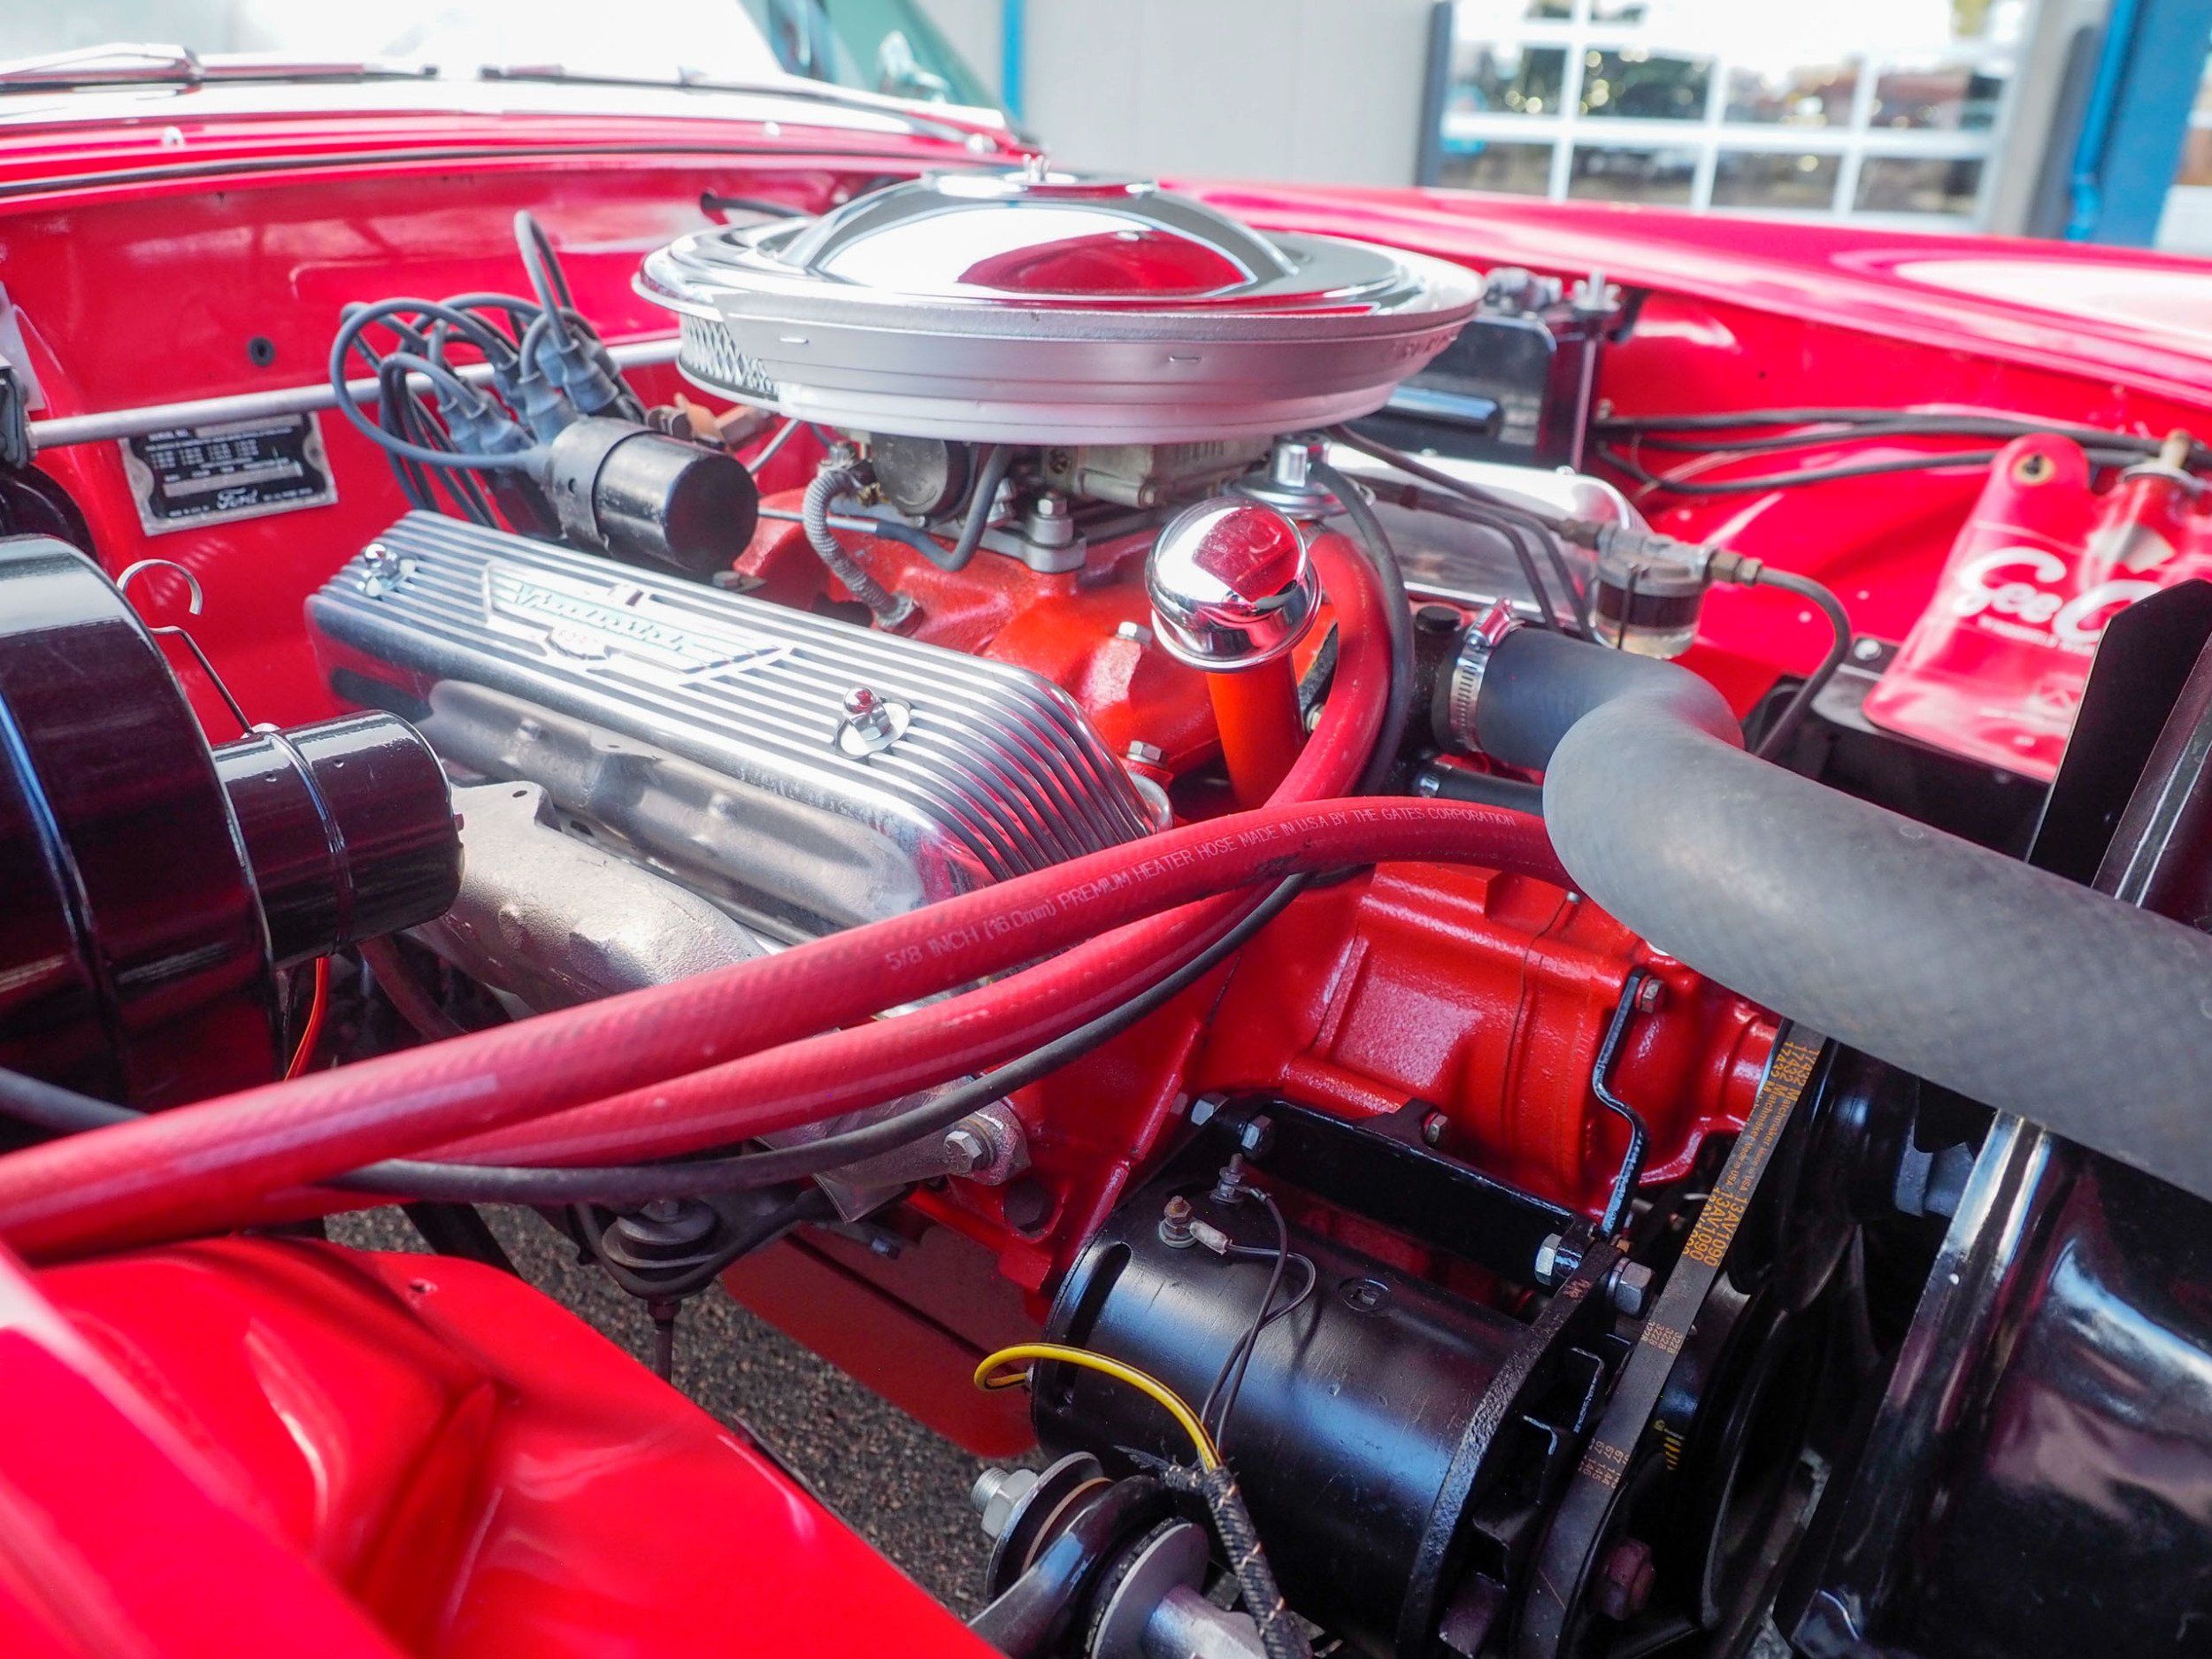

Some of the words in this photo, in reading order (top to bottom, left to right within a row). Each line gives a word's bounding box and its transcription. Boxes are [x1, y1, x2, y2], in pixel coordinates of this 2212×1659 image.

[217, 487, 258, 510] Ford
[885, 945, 924, 972] 5/8
[928, 926, 980, 958] INCH
[1056, 871, 1133, 910] PREMIUM
[1132, 849, 1195, 882] HEATER
[1197, 836, 1239, 861] HOSE
[1237, 824, 1279, 848] MADE
[1280, 821, 1296, 837] IN
[1329, 810, 1347, 827] BY
[1350, 808, 1377, 824] THE
[1382, 807, 1426, 822] GATES
[1428, 806, 1517, 827] CORPORATION
[1779, 1045, 1808, 1082] 17432
[1793, 1049, 1820, 1086] 17432
[1750, 1084, 1789, 1141] Matchmaker
[1763, 1088, 1801, 1146] Matchmaker
[1689, 1191, 1733, 1261] 13AV1090
[1703, 1197, 1747, 1267] 13AV1090
[1648, 1324, 1664, 1346] 3228
[1657, 1327, 1674, 1350] 3228
[1667, 1332, 1683, 1354] 3228
[1594, 1440, 1604, 1455] 67
[1603, 1445, 1615, 1460] 67
[1612, 1449, 1624, 1464] 67
